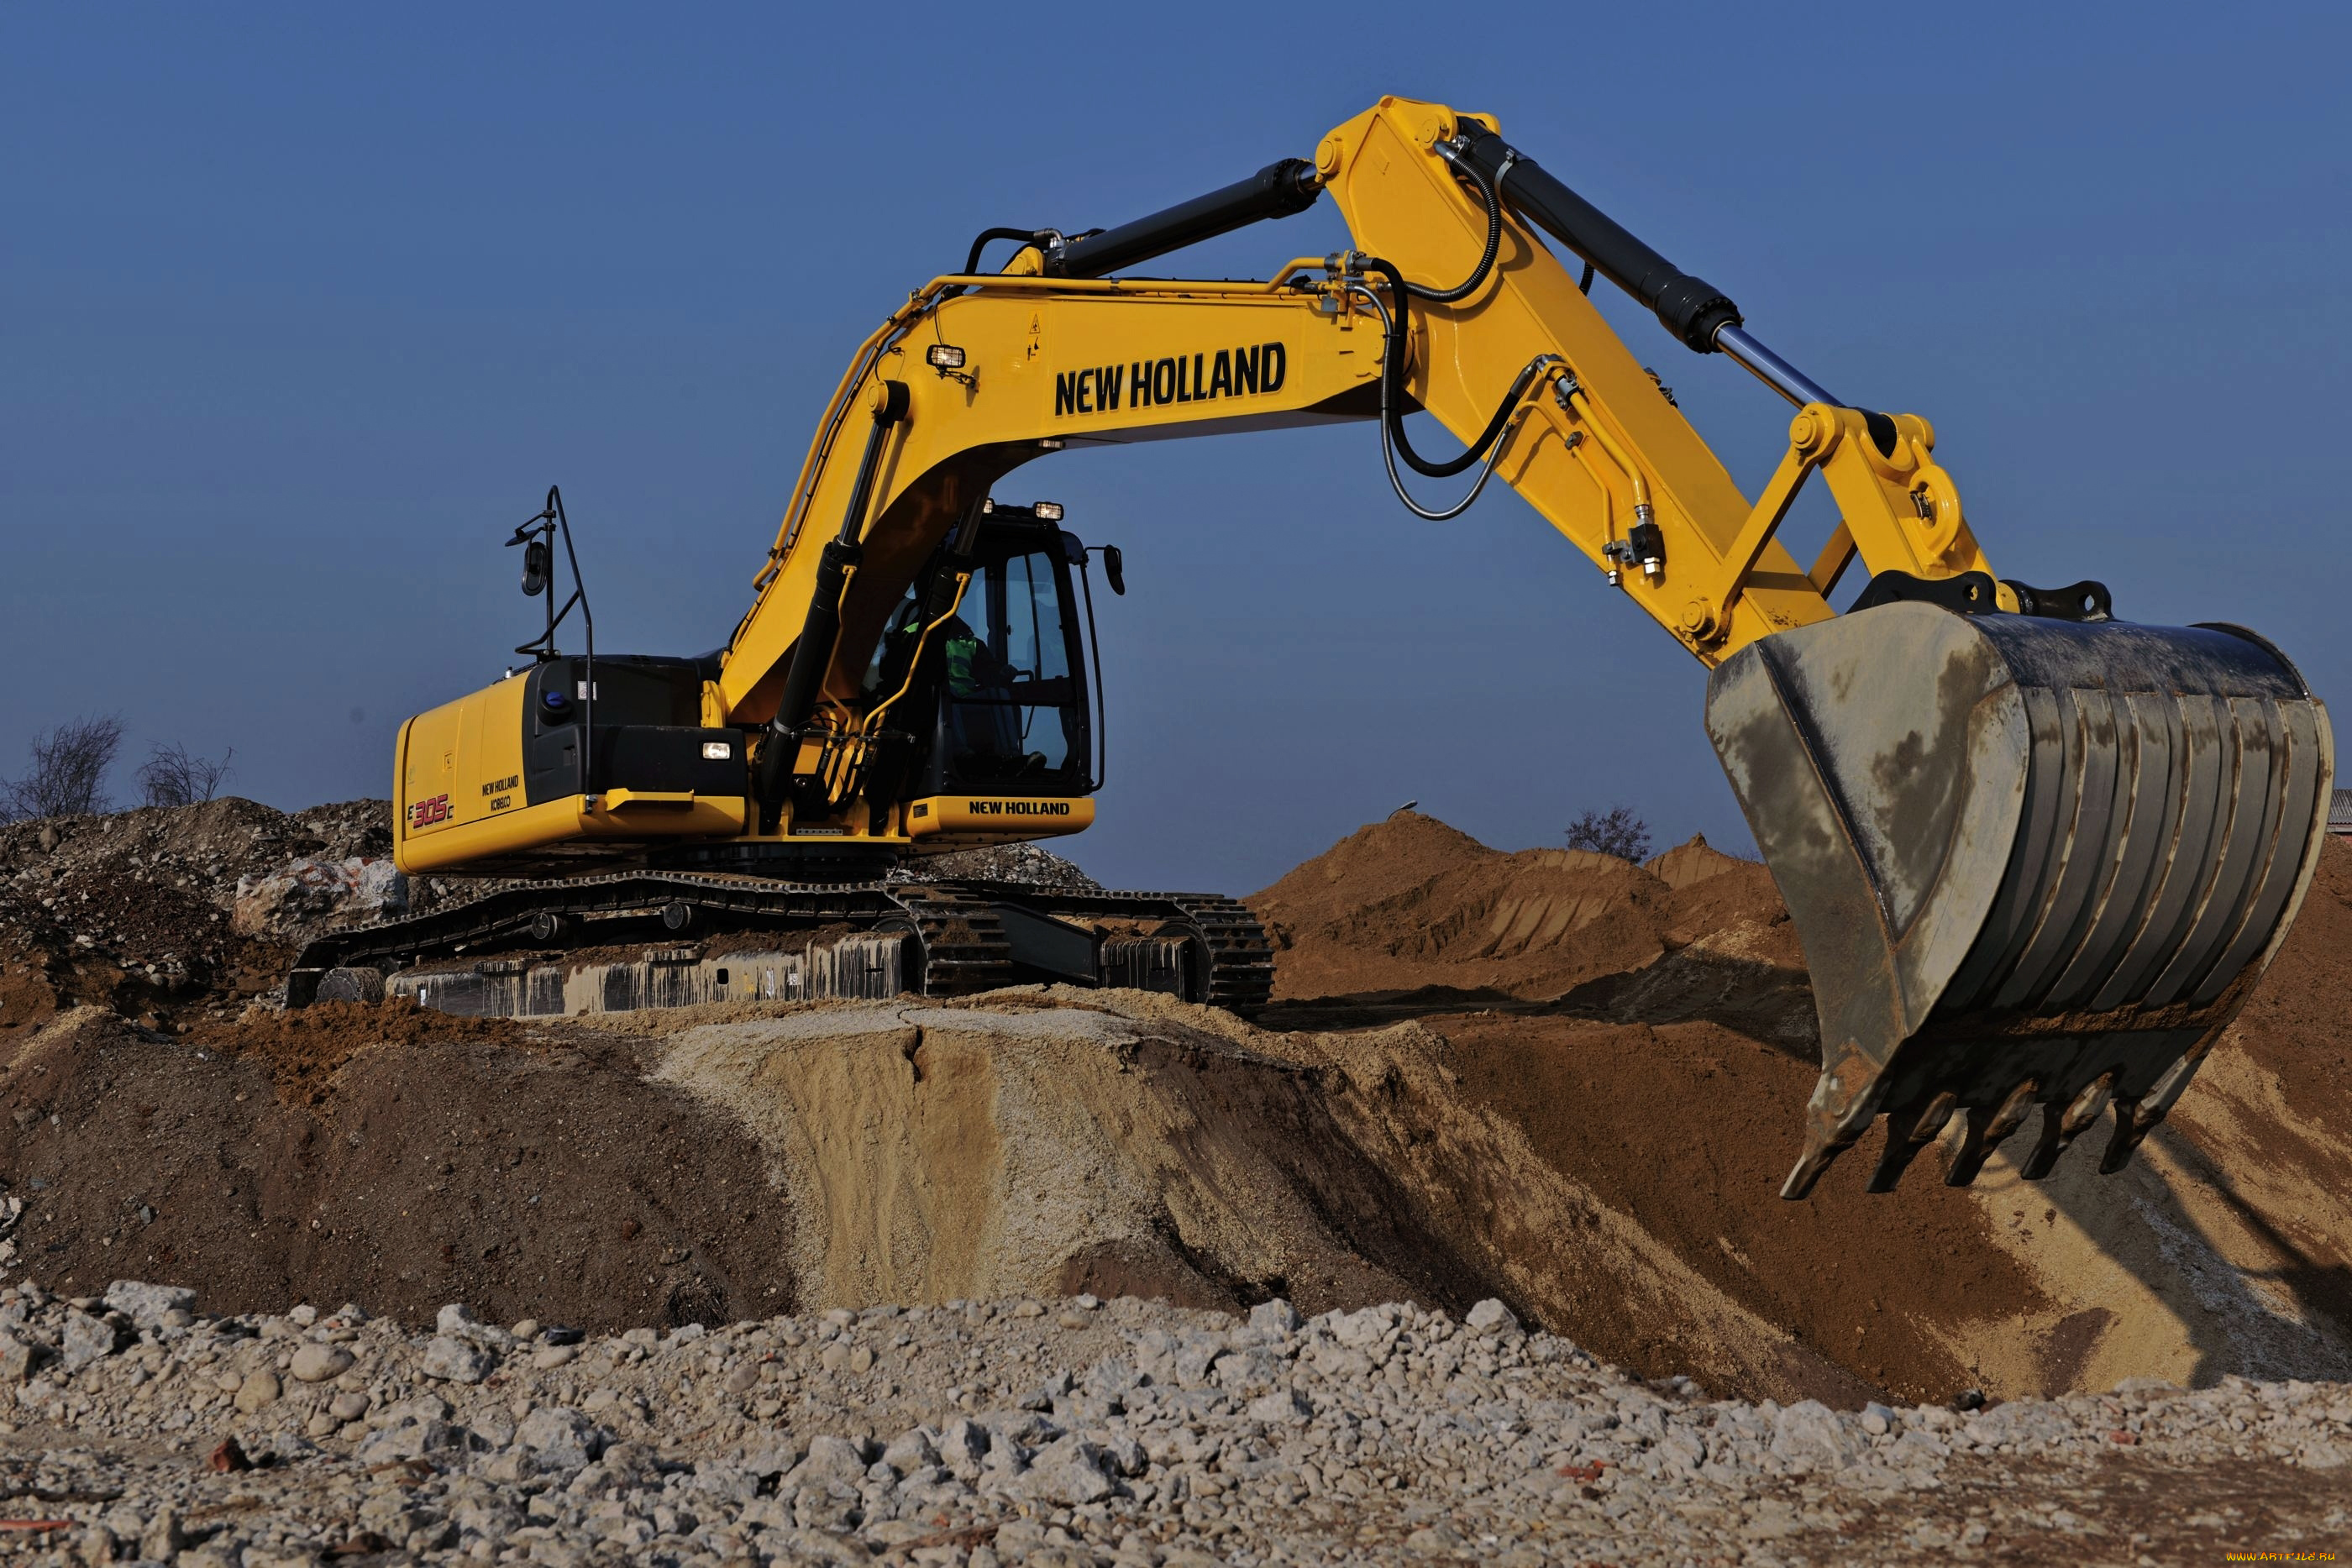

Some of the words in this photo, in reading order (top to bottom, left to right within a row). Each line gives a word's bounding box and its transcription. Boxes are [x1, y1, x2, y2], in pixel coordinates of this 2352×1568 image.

[1055, 364, 1124, 417] NEW
[1129, 341, 1287, 410] HOLLAND
[482, 782, 495, 796] NEW
[495, 774, 518, 793] HOLLAND
[491, 794, 511, 811] KOBELCO
[969, 801, 1002, 815] NEW
[1005, 801, 1069, 815] HOLLAND
